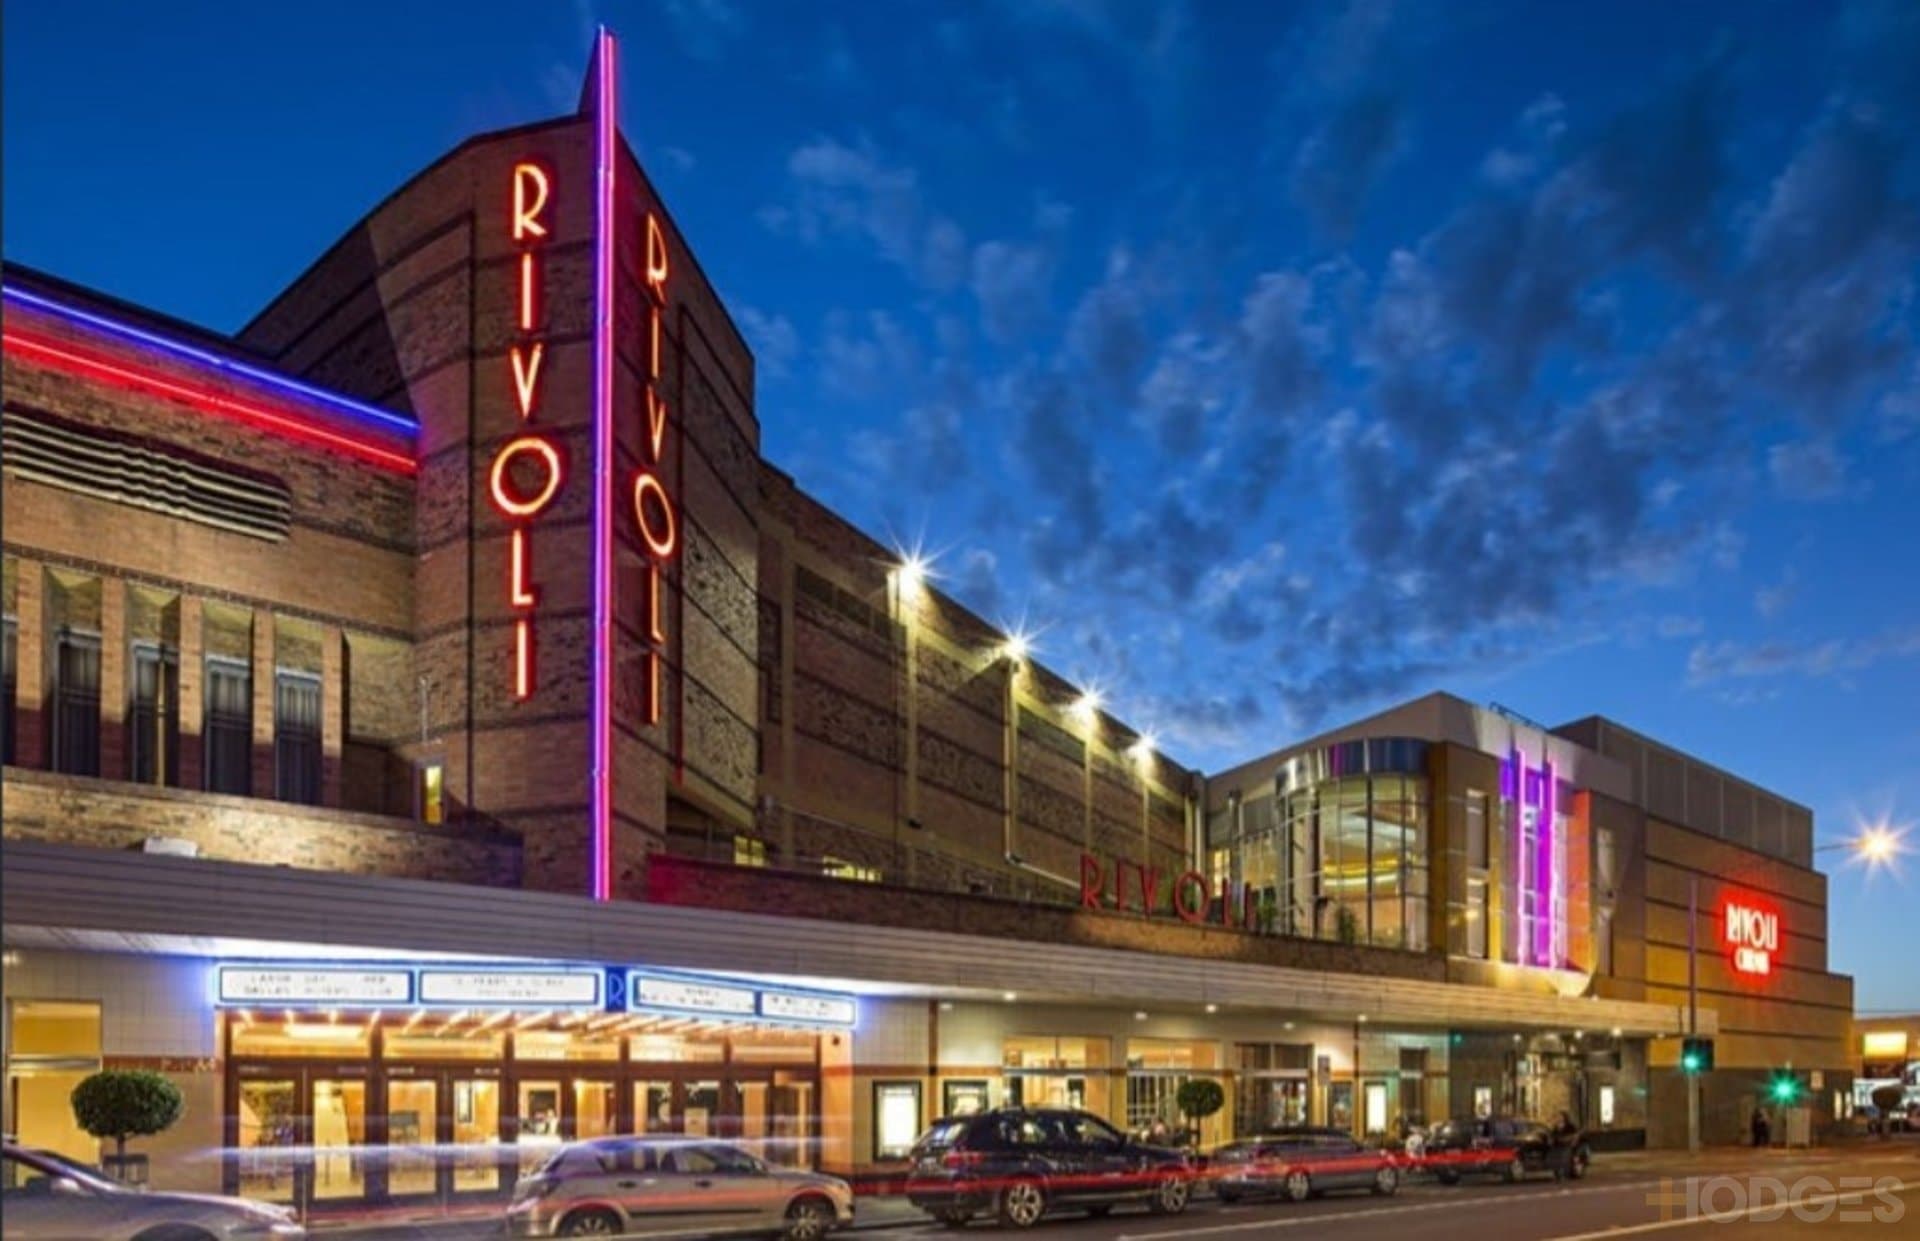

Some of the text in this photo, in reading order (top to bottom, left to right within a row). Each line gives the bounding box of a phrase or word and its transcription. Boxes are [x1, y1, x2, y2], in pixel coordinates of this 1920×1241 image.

[491, 163, 560, 698] RIVOLI
[634, 213, 676, 724] RIVOLI
[1726, 903, 1778, 951] RIVOLI
